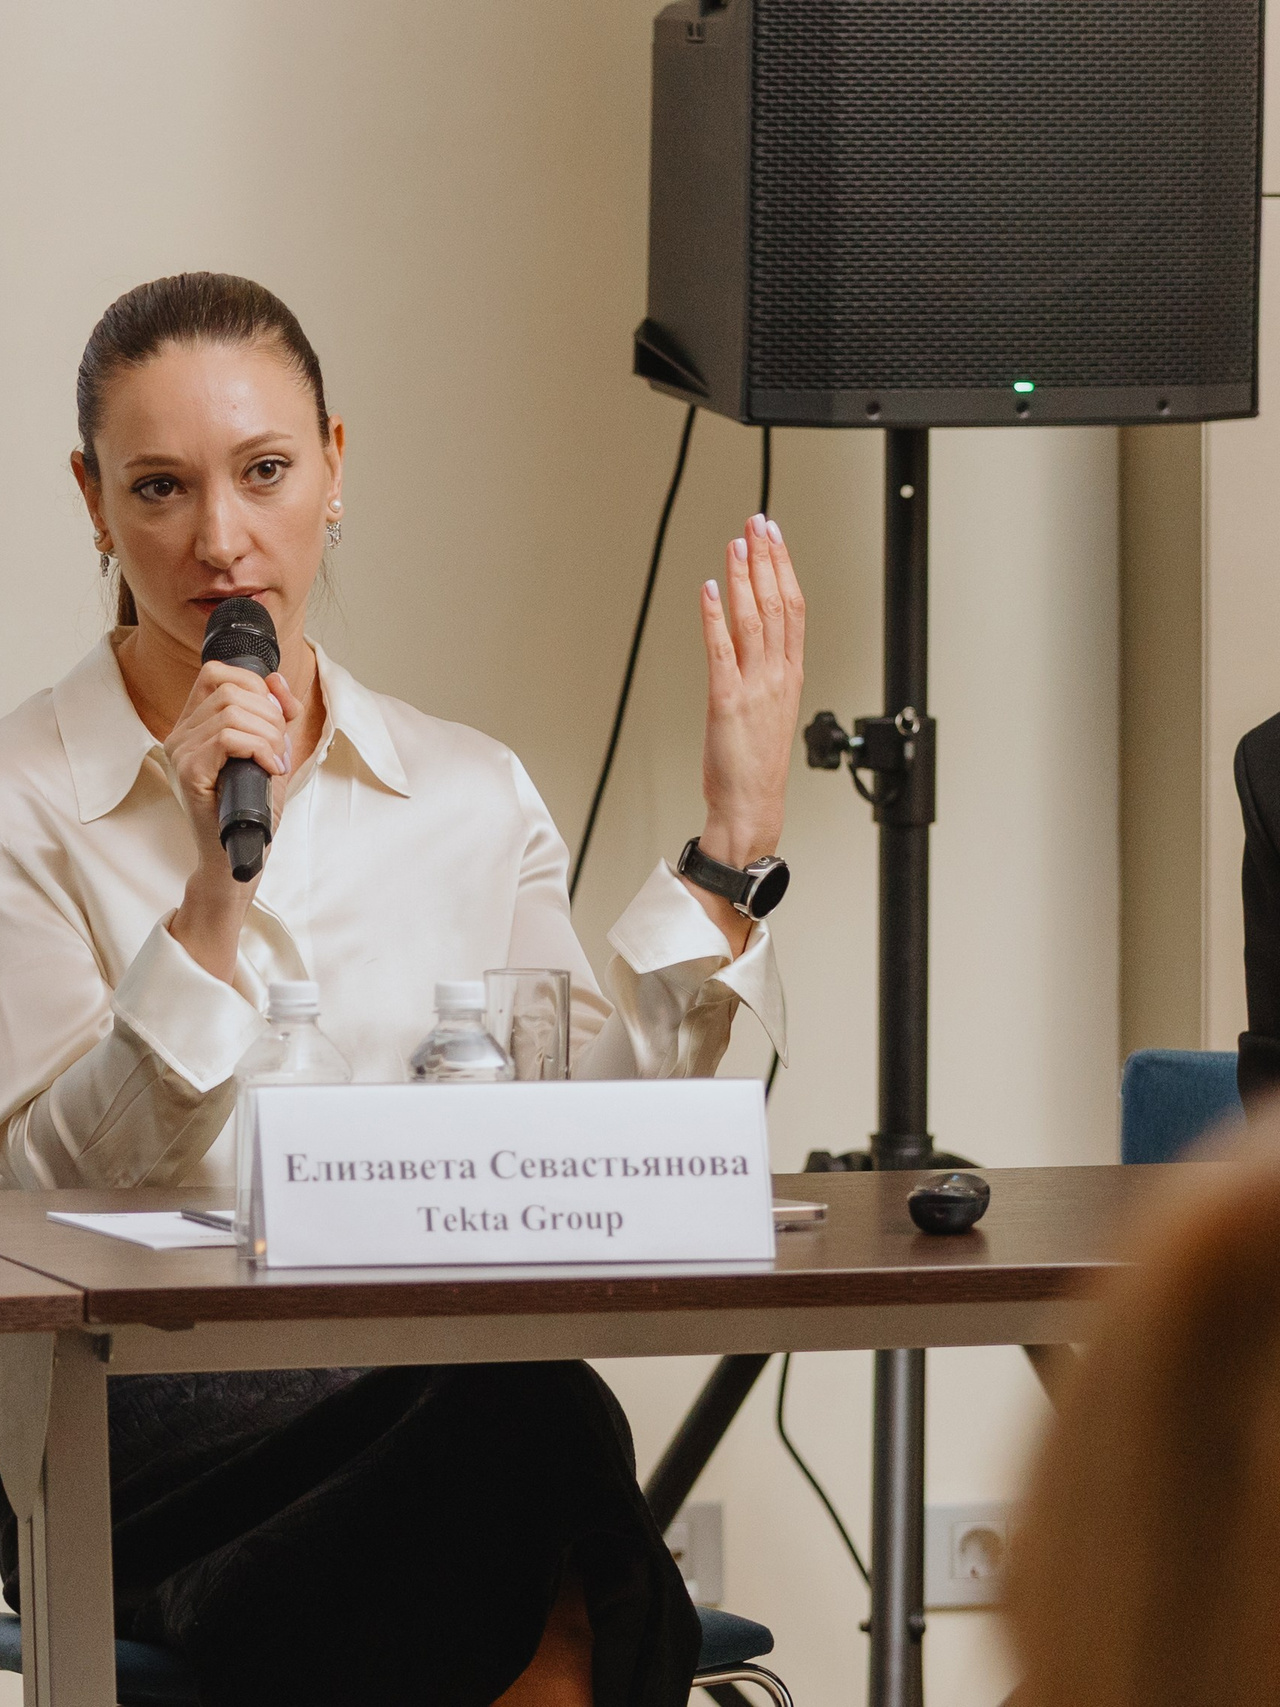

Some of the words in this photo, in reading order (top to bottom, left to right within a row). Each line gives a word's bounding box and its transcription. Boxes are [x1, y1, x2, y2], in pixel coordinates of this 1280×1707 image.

[284, 1153, 477, 1182] Елизавета
[490, 1150, 750, 1179] Севастьянова
[418, 1206, 509, 1232] Tekta
[521, 1204, 624, 1236] Group
